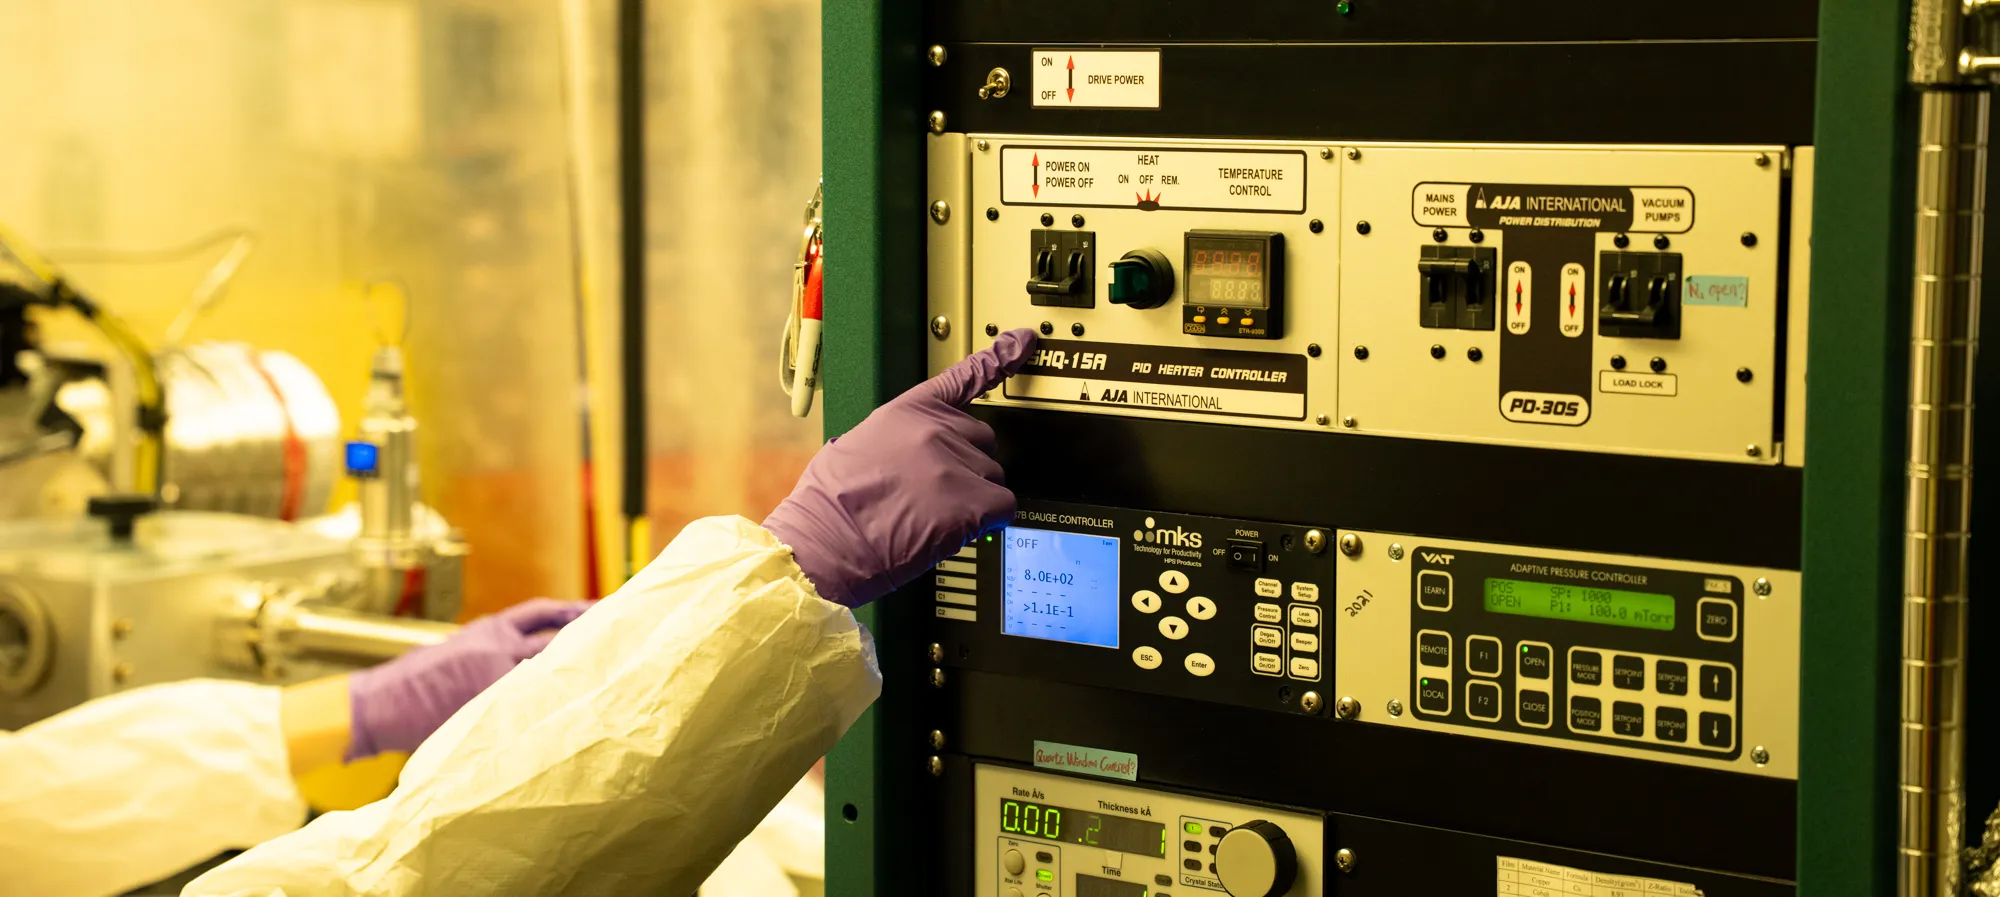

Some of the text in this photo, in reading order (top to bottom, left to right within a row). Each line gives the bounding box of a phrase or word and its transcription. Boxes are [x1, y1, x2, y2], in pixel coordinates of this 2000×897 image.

[1041, 57, 1053, 67] ON
[1088, 74, 1145, 86] DRIVE POWER
[1041, 90, 1056, 100] OFF
[1137, 154, 1159, 166] HEAT
[1045, 160, 1090, 173] POWER ON
[1218, 167, 1283, 181] TEMPERATURE
[1045, 176, 1094, 189] POWER OFF
[1118, 174, 1180, 186] ON OFF REM.
[1229, 184, 1271, 197] CONTROL
[1426, 193, 1455, 203] MAINS
[1641, 197, 1685, 208] VACUUM
[1490, 195, 1626, 213] AJA INTERNATIONAL
[1423, 206, 1457, 217] POWER
[1499, 216, 1601, 228] POWER DISTRIBUTION
[1645, 212, 1681, 223] PUMPS
[1514, 266, 1525, 274] ON
[1708, 282, 1746, 302] open?
[1511, 321, 1526, 330] OFF
[1564, 324, 1579, 333] OFF
[1132, 362, 1152, 374] PID
[1158, 364, 1204, 378] HEATER
[1211, 367, 1287, 384] CONTROLLER
[1613, 378, 1664, 389] LOAD LOCK
[1100, 388, 1223, 410] AJA INTERNATIONAL
[1510, 398, 1579, 416] PD-30S
[1028, 511, 1057, 523] GAUGE
[1058, 514, 1114, 529] CONTROLLER
[1156, 525, 1203, 549] mks
[1235, 529, 1259, 538] POWER
[1016, 537, 1039, 549] OFF
[1133, 543, 1202, 559] Technology for Productivity
[1212, 548, 1226, 556] OFF
[1176, 558, 1202, 567] Products
[1268, 554, 1279, 562] ON
[1420, 552, 1455, 565] VAT
[1024, 569, 1074, 586] 8.0E+02
[1510, 563, 1648, 585] ADAPTIVE PRESSURE CONTROLLER
[1424, 586, 1446, 595] LEARN
[1490, 580, 1612, 604] POS SP: 1000
[1344, 589, 1374, 618] 2021
[1490, 594, 1673, 624] OPEN P1: 100.0 mTorr
[1023, 601, 1074, 618] >1.1E-1
[1706, 615, 1727, 625] ZERO
[1260, 631, 1275, 639] Degas
[1258, 637, 1276, 645] On/Off
[1295, 638, 1312, 646] Beeper
[1420, 645, 1448, 656] REMOTE
[1140, 654, 1154, 662] ESC
[1524, 656, 1545, 667] OPEN
[1191, 661, 1207, 670] Enter
[1572, 663, 1600, 673] PRESSURE
[1576, 672, 1596, 681] MODE
[1614, 668, 1643, 678] SETPOINT
[1657, 673, 1686, 683] SETPOINT
[1668, 682, 1675, 691] 2
[1422, 690, 1444, 700] LOCAL
[1522, 702, 1546, 713] CLOSE
[1571, 708, 1600, 719] POSITION
[1614, 714, 1642, 724] SETPOINT
[1576, 718, 1596, 727] MODE
[1625, 723, 1631, 732] 3
[1657, 719, 1686, 728] SETPOINT
[1668, 728, 1674, 737] 4
[1012, 786, 1030, 798] Rate
[1097, 800, 1139, 815] Thickness
[1003, 801, 1060, 839] 0.00
[1101, 865, 1122, 877] Time
[1502, 860, 1515, 868] Film
[1522, 863, 1544, 872] Material
[1184, 876, 1206, 886] Crystal
[1531, 877, 1551, 886] Copper
[1035, 883, 1052, 891] Shutter
